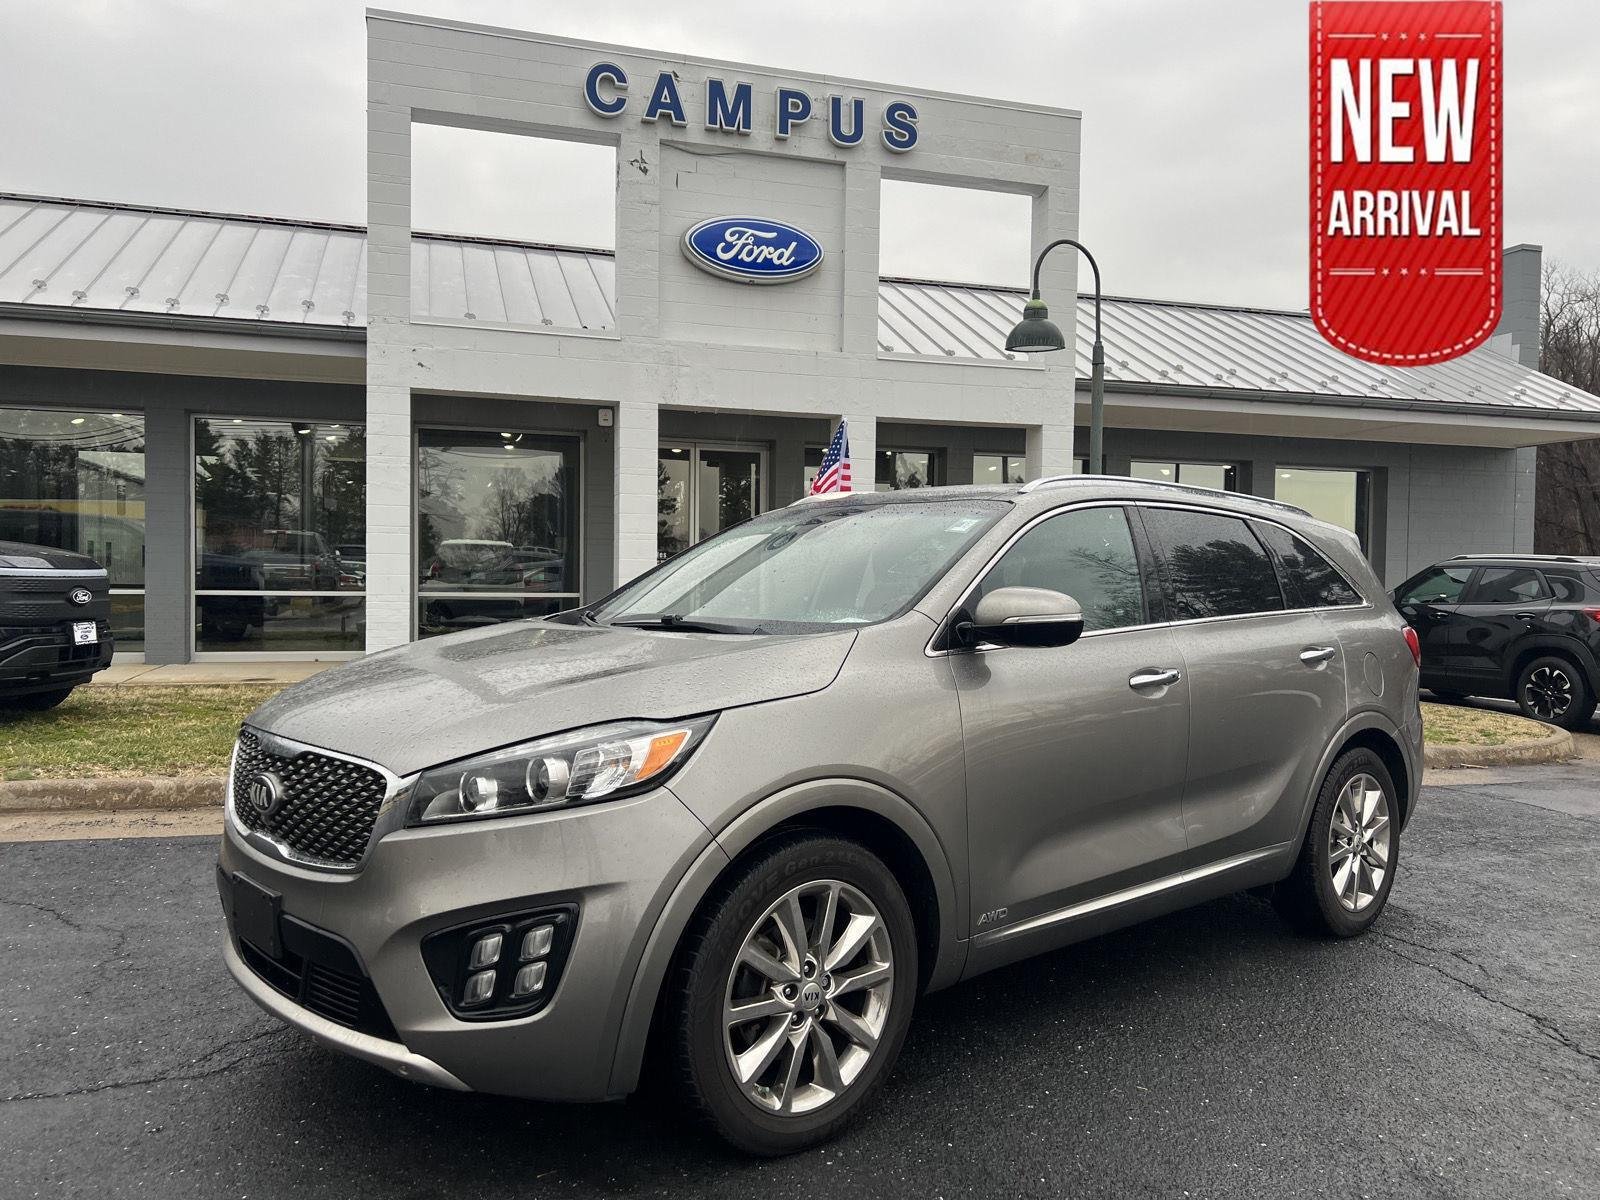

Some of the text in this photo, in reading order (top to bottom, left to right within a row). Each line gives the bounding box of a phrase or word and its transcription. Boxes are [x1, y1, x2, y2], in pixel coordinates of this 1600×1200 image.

[583, 60, 920, 152] CAMPUS
[715, 226, 797, 266] Ford
[249, 782, 268, 807] KIA
[976, 907, 1008, 927] AWD
[804, 991, 820, 1002] KIA
